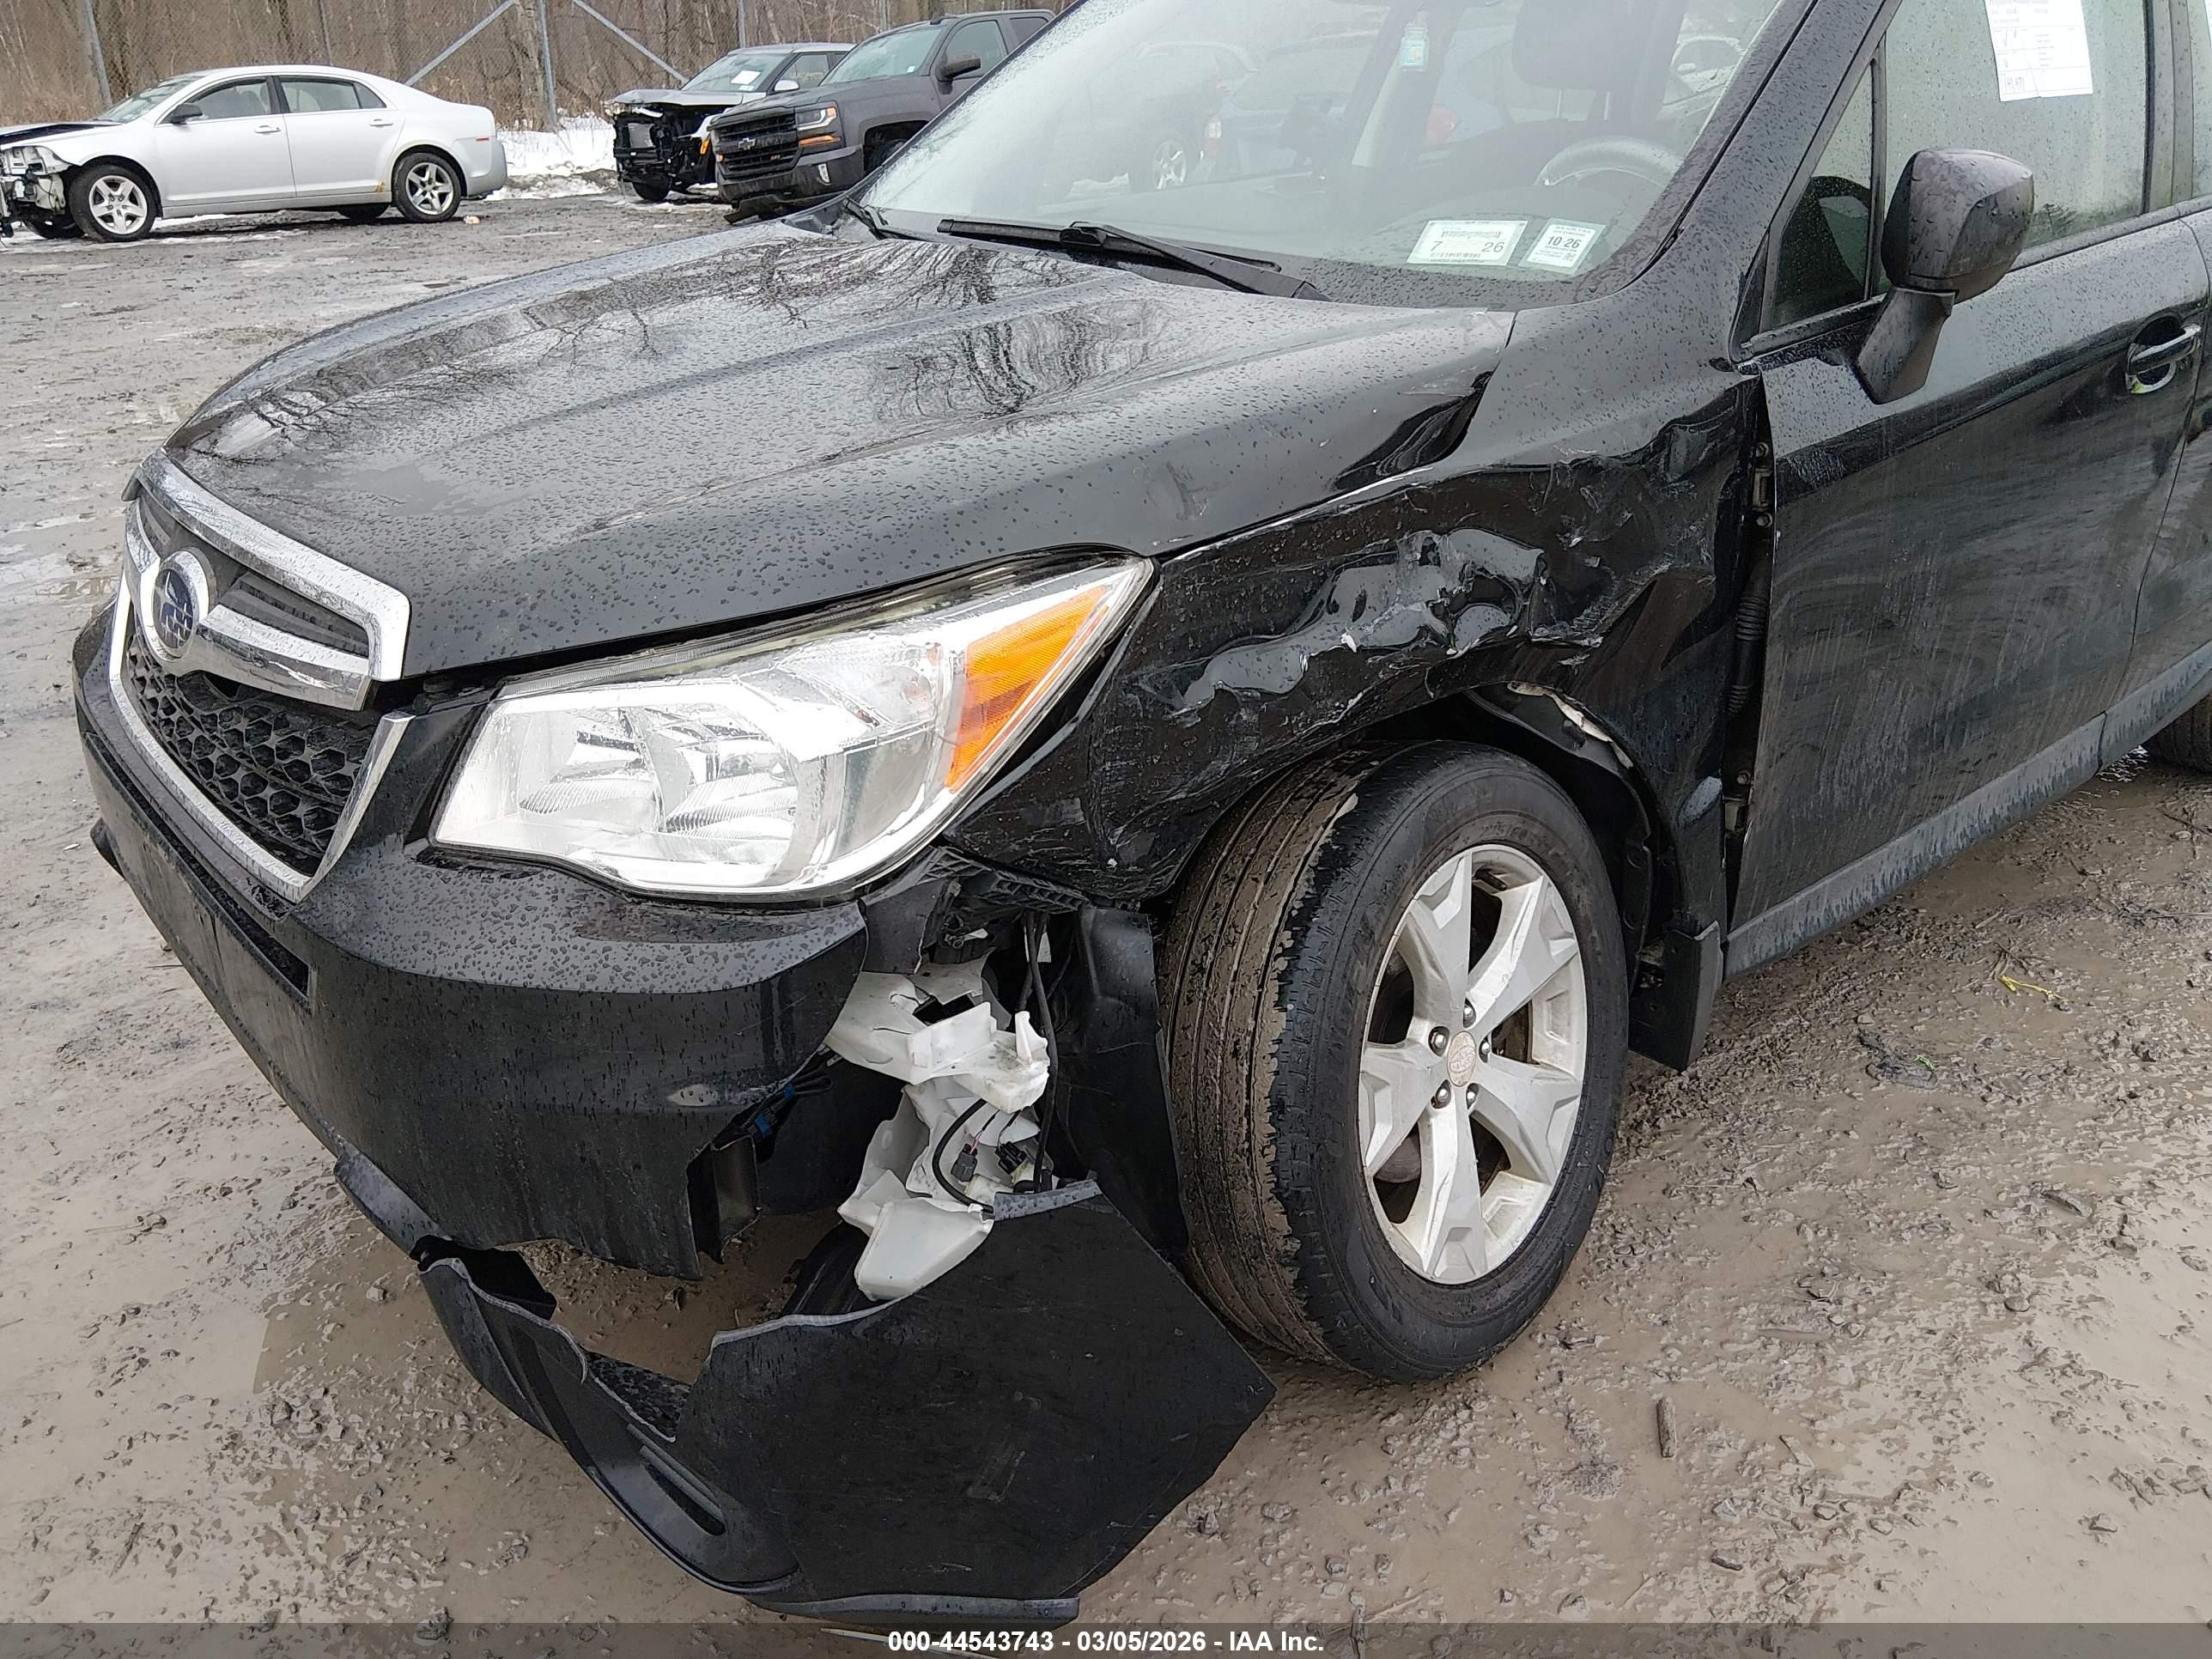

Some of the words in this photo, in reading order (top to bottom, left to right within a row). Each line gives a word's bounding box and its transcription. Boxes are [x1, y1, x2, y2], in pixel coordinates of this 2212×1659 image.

[1431, 240, 1443, 252] 7
[1481, 241, 1505, 252] 26
[1547, 235, 1563, 246] 10
[1563, 238, 1583, 249] 26
